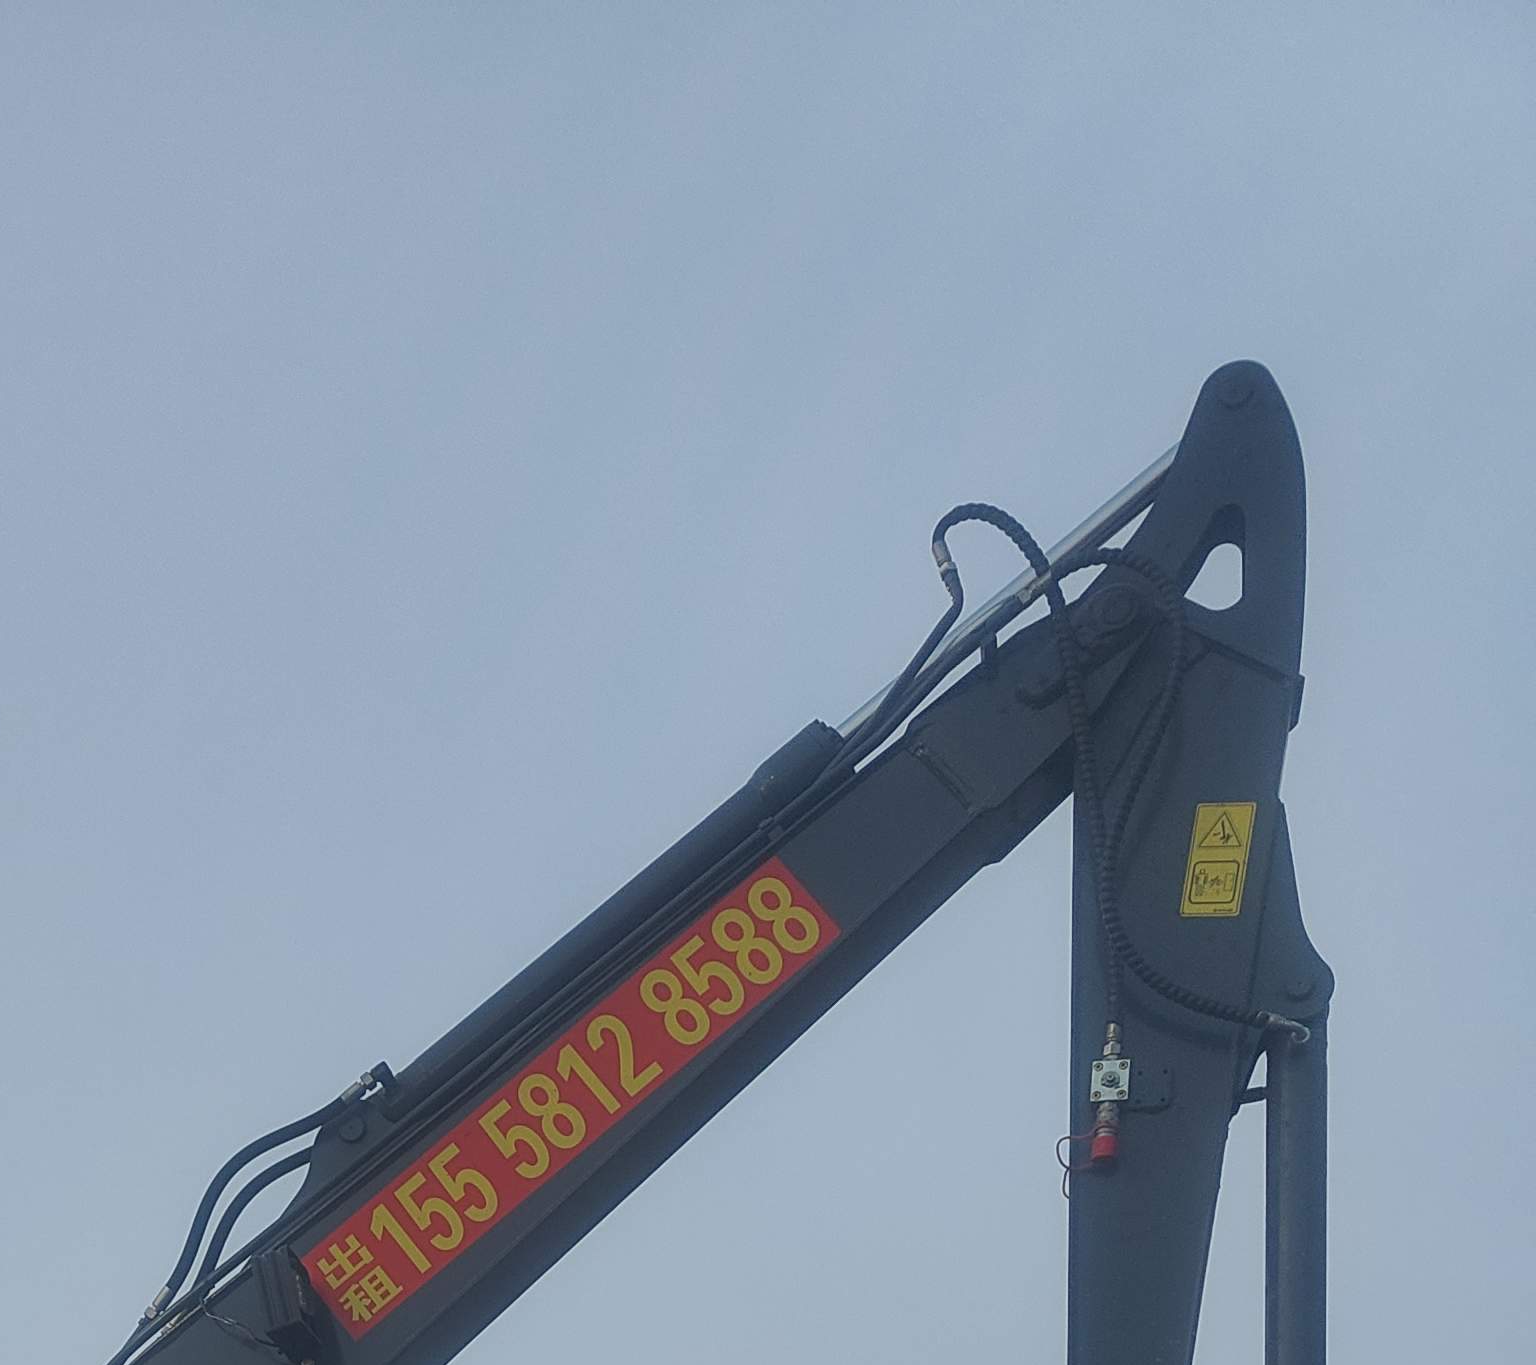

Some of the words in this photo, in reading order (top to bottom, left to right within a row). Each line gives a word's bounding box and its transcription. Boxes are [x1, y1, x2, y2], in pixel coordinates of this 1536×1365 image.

[370, 1143, 498, 1274] 155
[478, 1014, 663, 1180] 5812
[639, 877, 820, 1046] 8588
[317, 1234, 402, 1322] 出租
